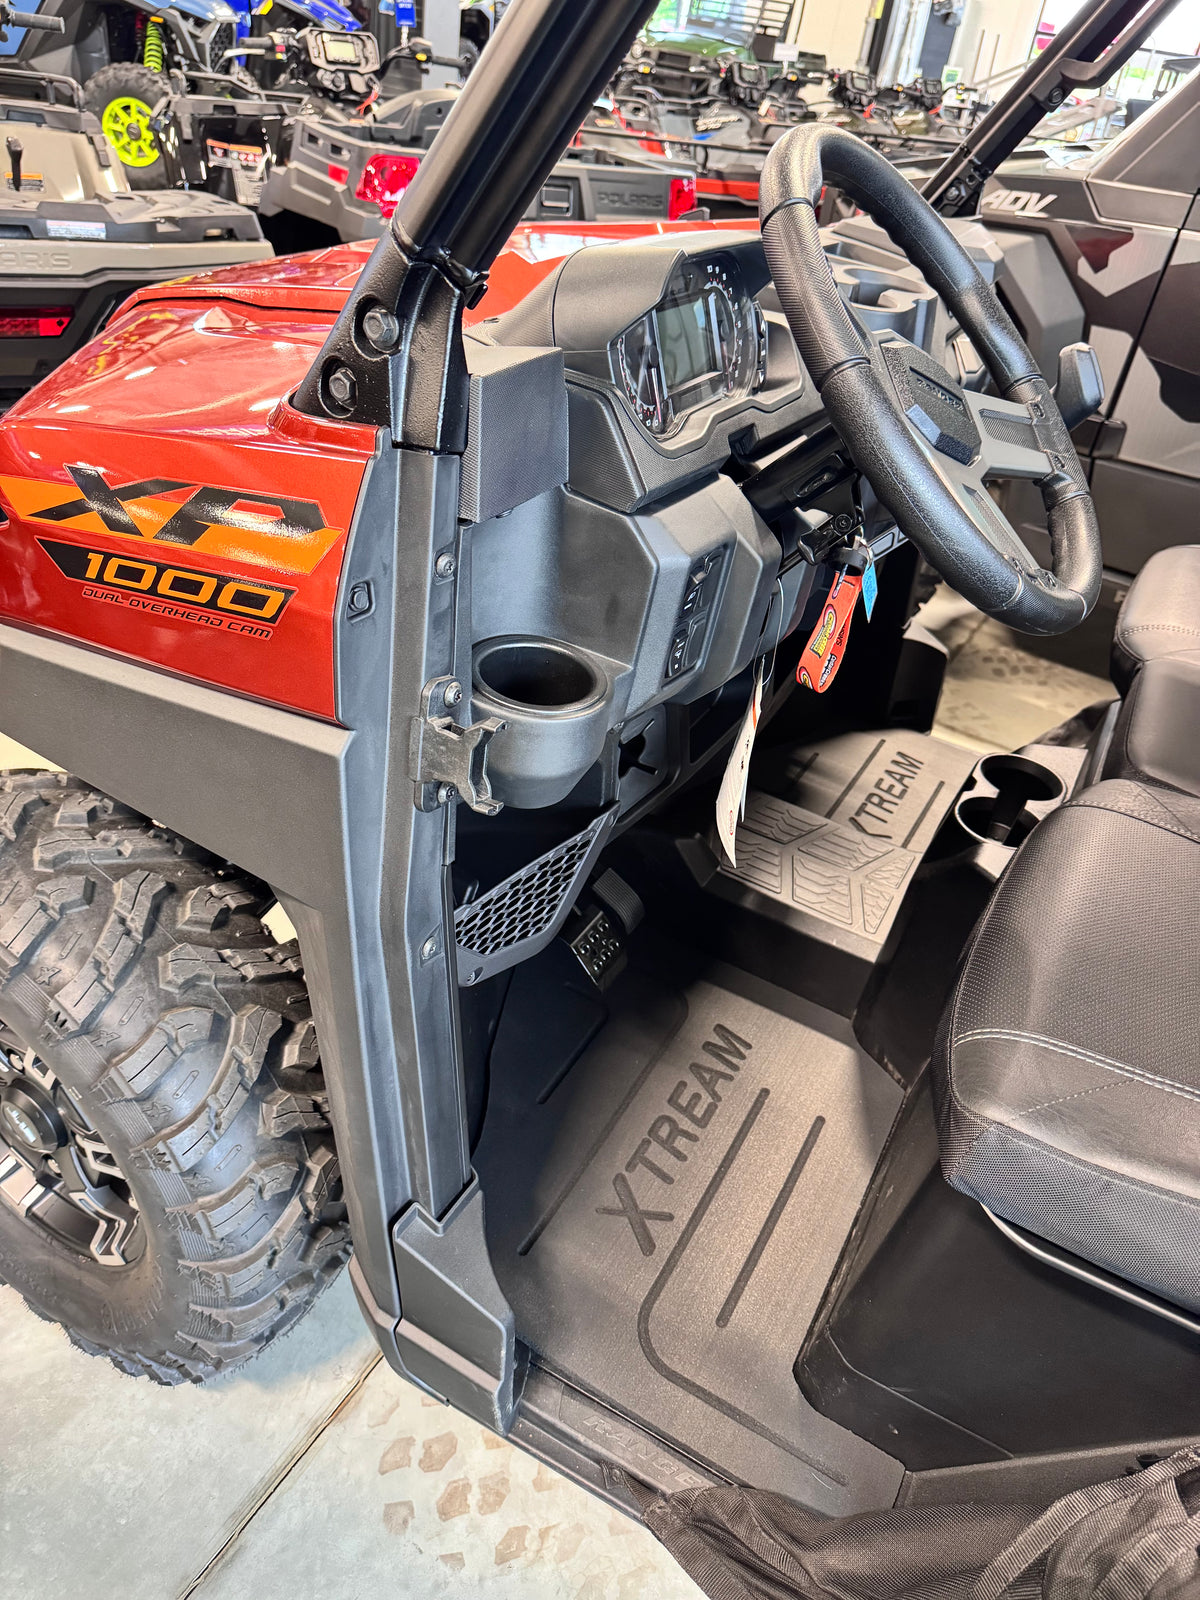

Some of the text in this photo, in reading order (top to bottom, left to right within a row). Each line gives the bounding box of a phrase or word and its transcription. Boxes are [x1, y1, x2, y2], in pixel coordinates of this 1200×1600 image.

[26, 463, 328, 547] XP
[82, 587, 271, 639] DUAL OVERHEAD CAM
[84, 551, 286, 620] 1000
[595, 1023, 753, 1257] XTREAM
[583, 1415, 703, 1489] RANGE
